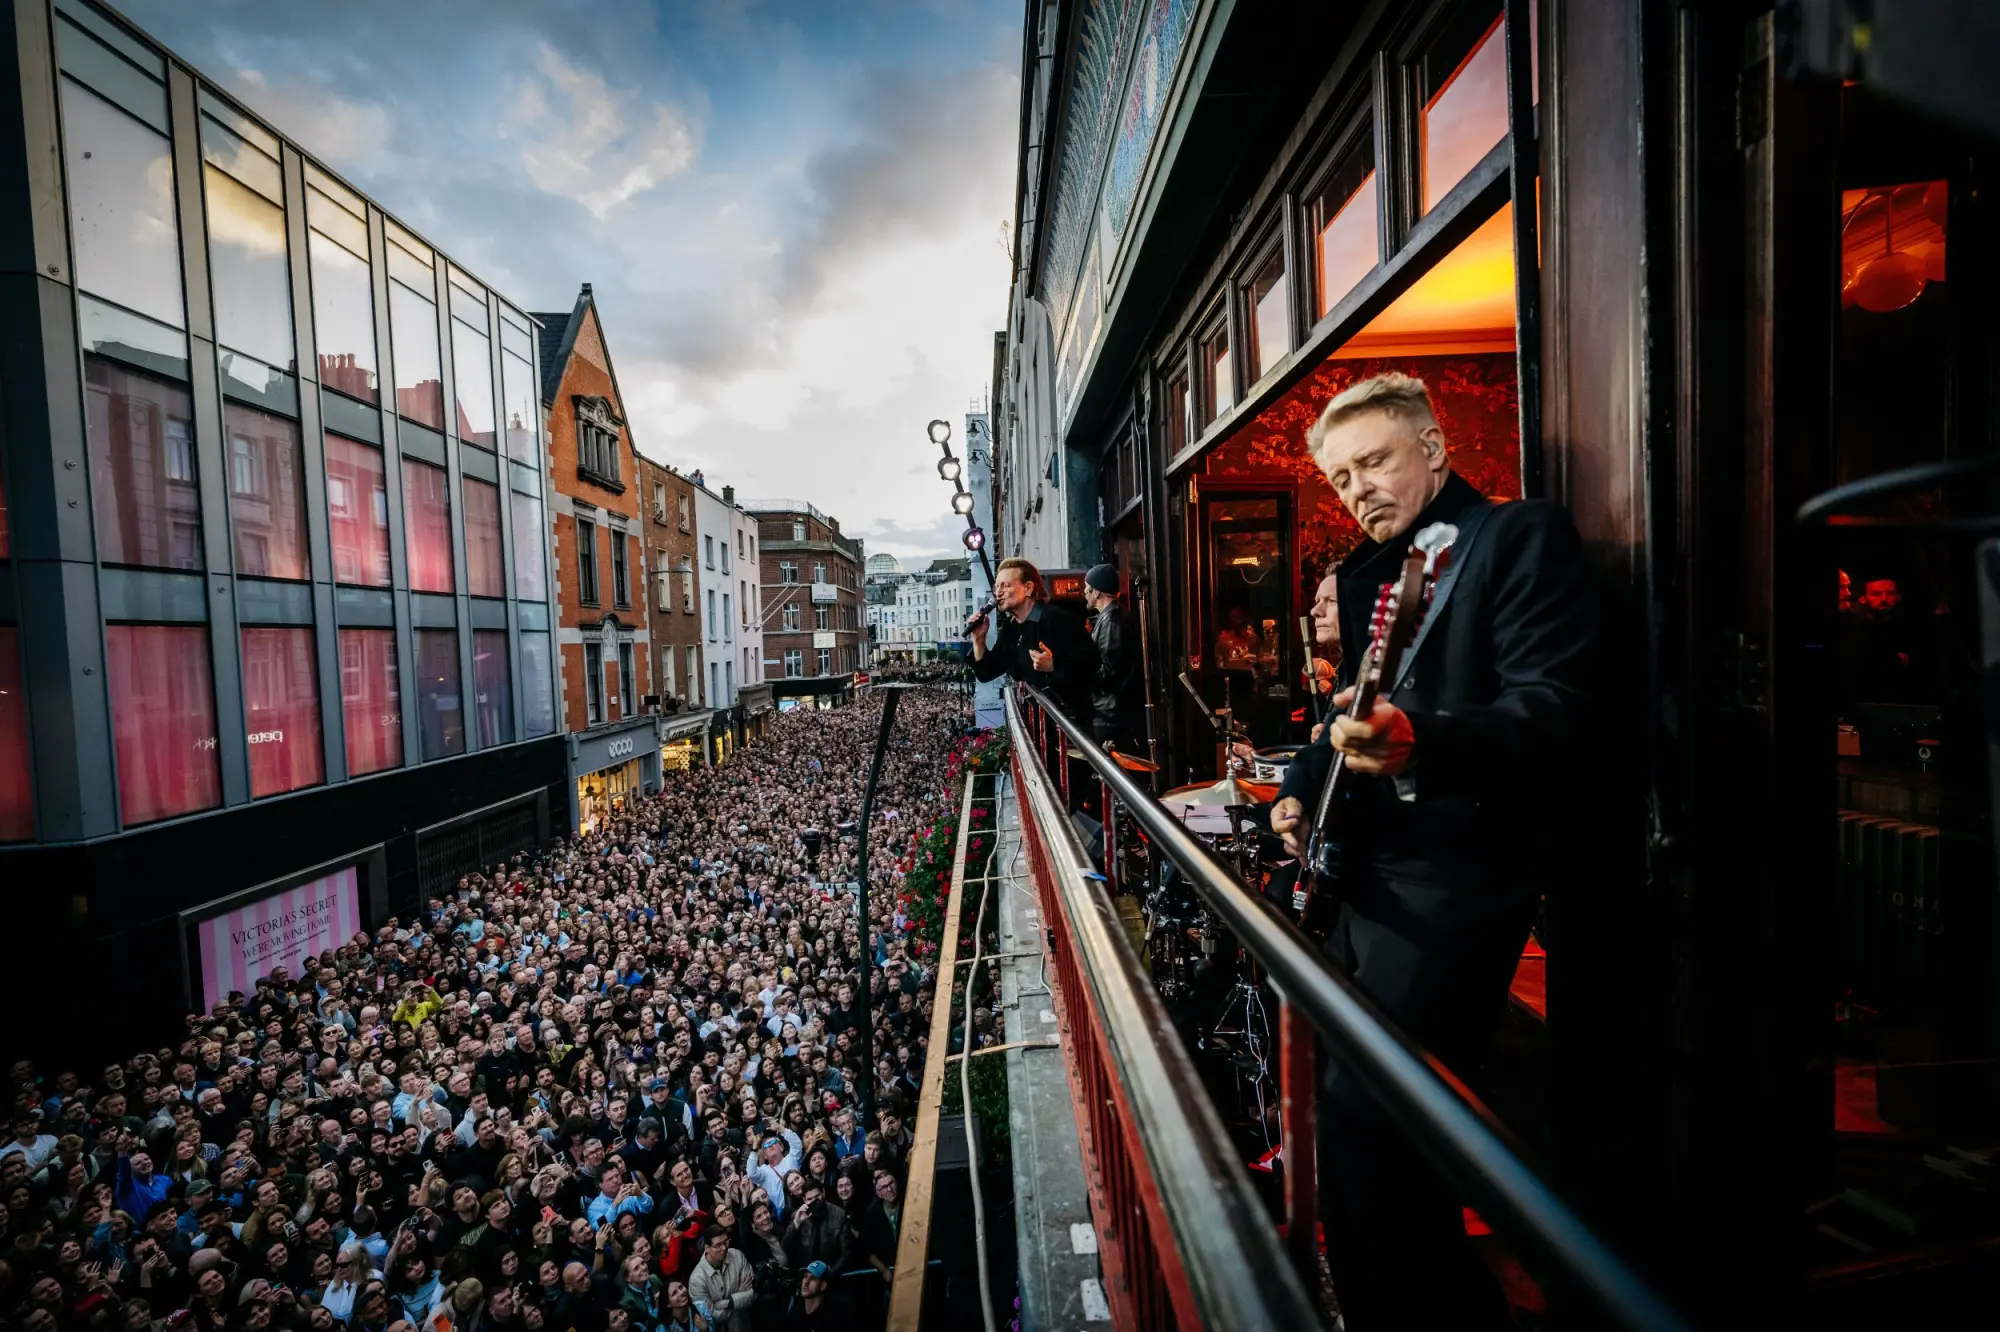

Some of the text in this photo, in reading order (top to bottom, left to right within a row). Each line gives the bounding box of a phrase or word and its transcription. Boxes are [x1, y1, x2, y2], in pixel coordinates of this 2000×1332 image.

[609, 738, 633, 757] ecco
[232, 894, 337, 945] VICTORIA'S SECRET
[271, 925, 306, 948] MOVING
[307, 914, 331, 932] HOME
